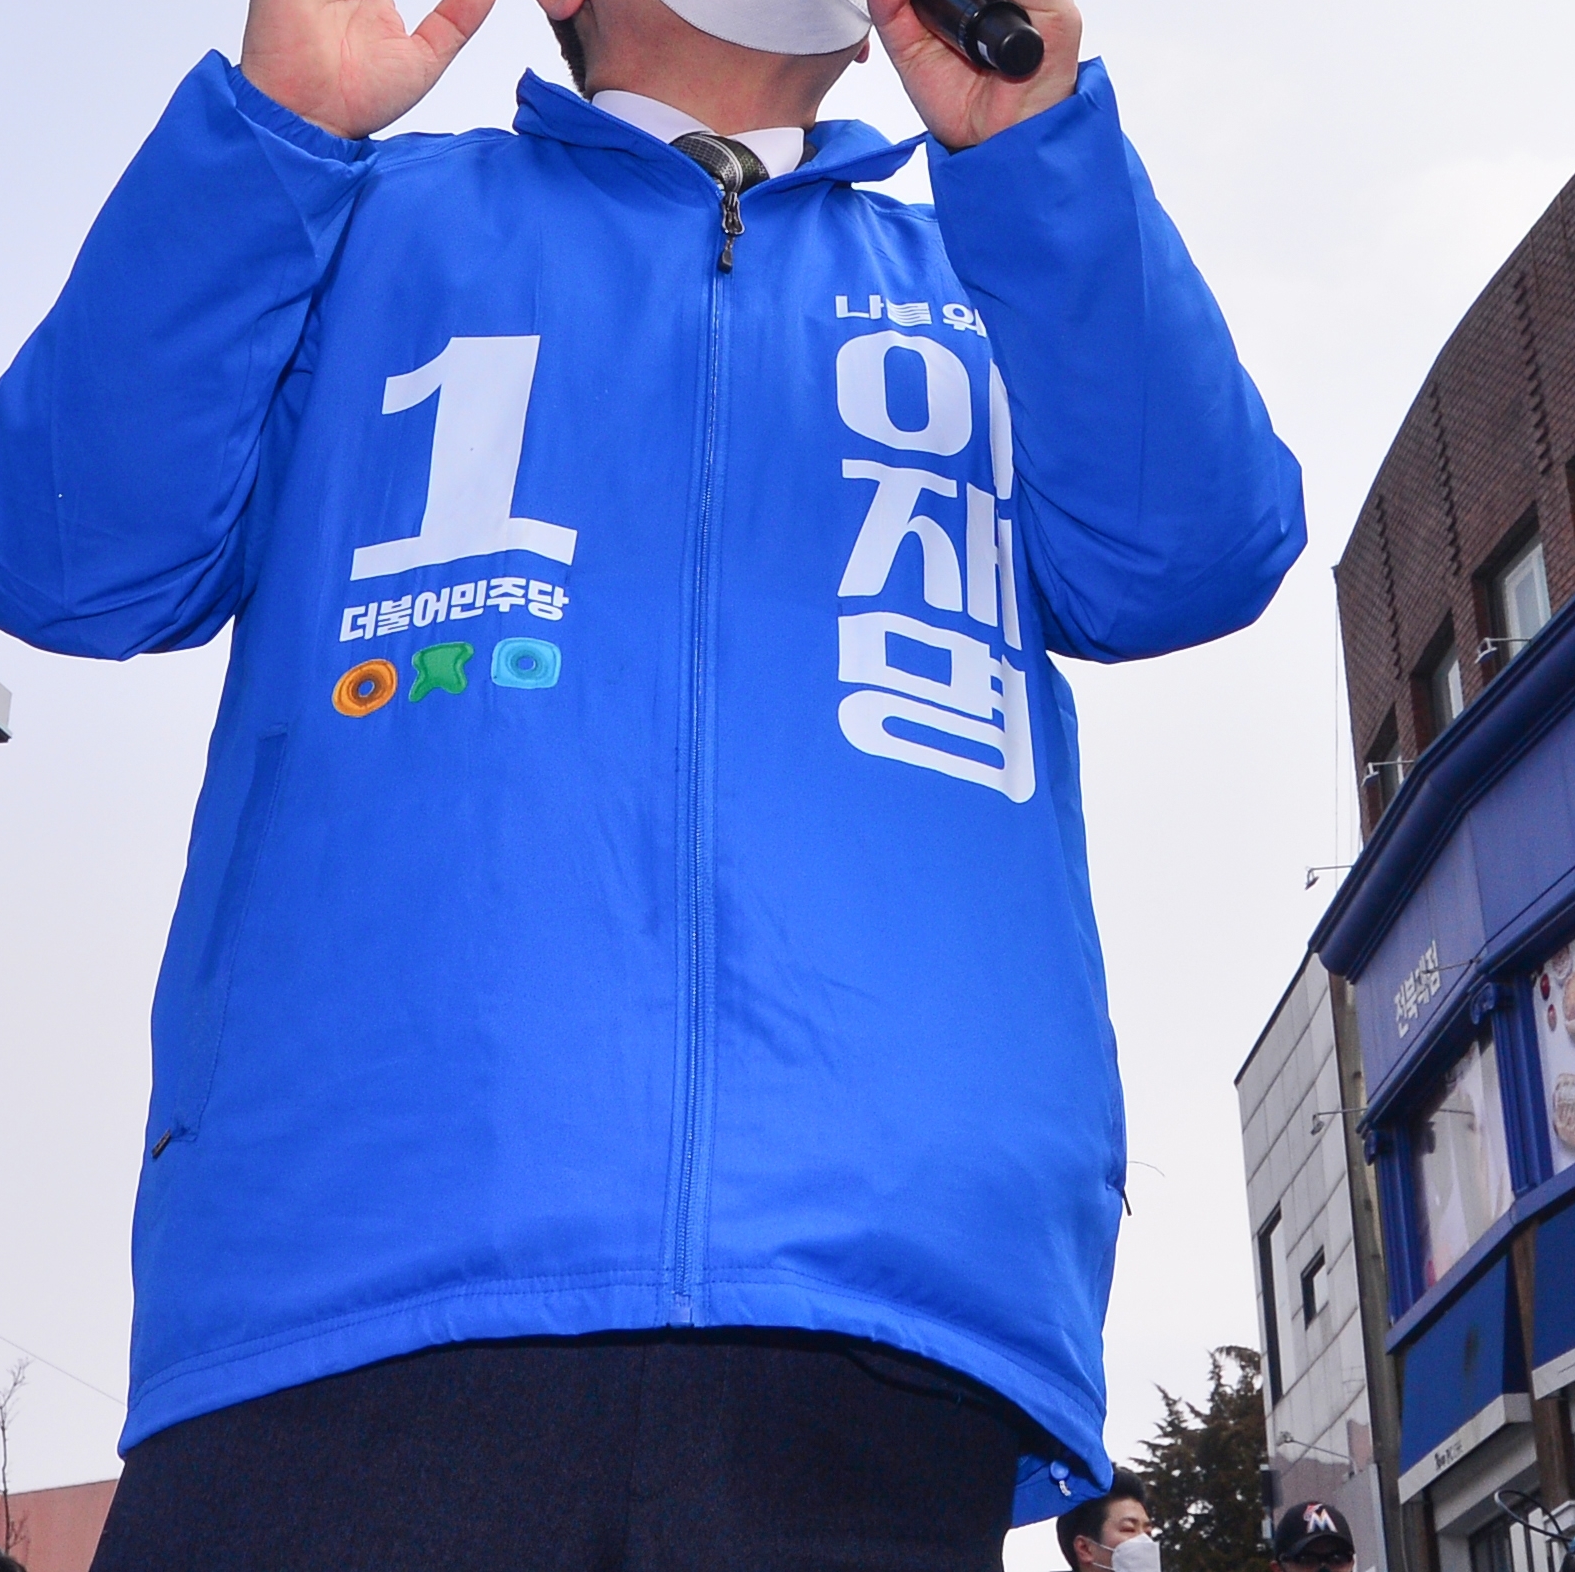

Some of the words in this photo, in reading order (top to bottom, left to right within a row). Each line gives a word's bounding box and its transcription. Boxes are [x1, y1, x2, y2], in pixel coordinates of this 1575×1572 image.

[351, 336, 577, 580] 1
[836, 330, 1036, 803] 이재명
[339, 577, 569, 642] 더불어민주당
